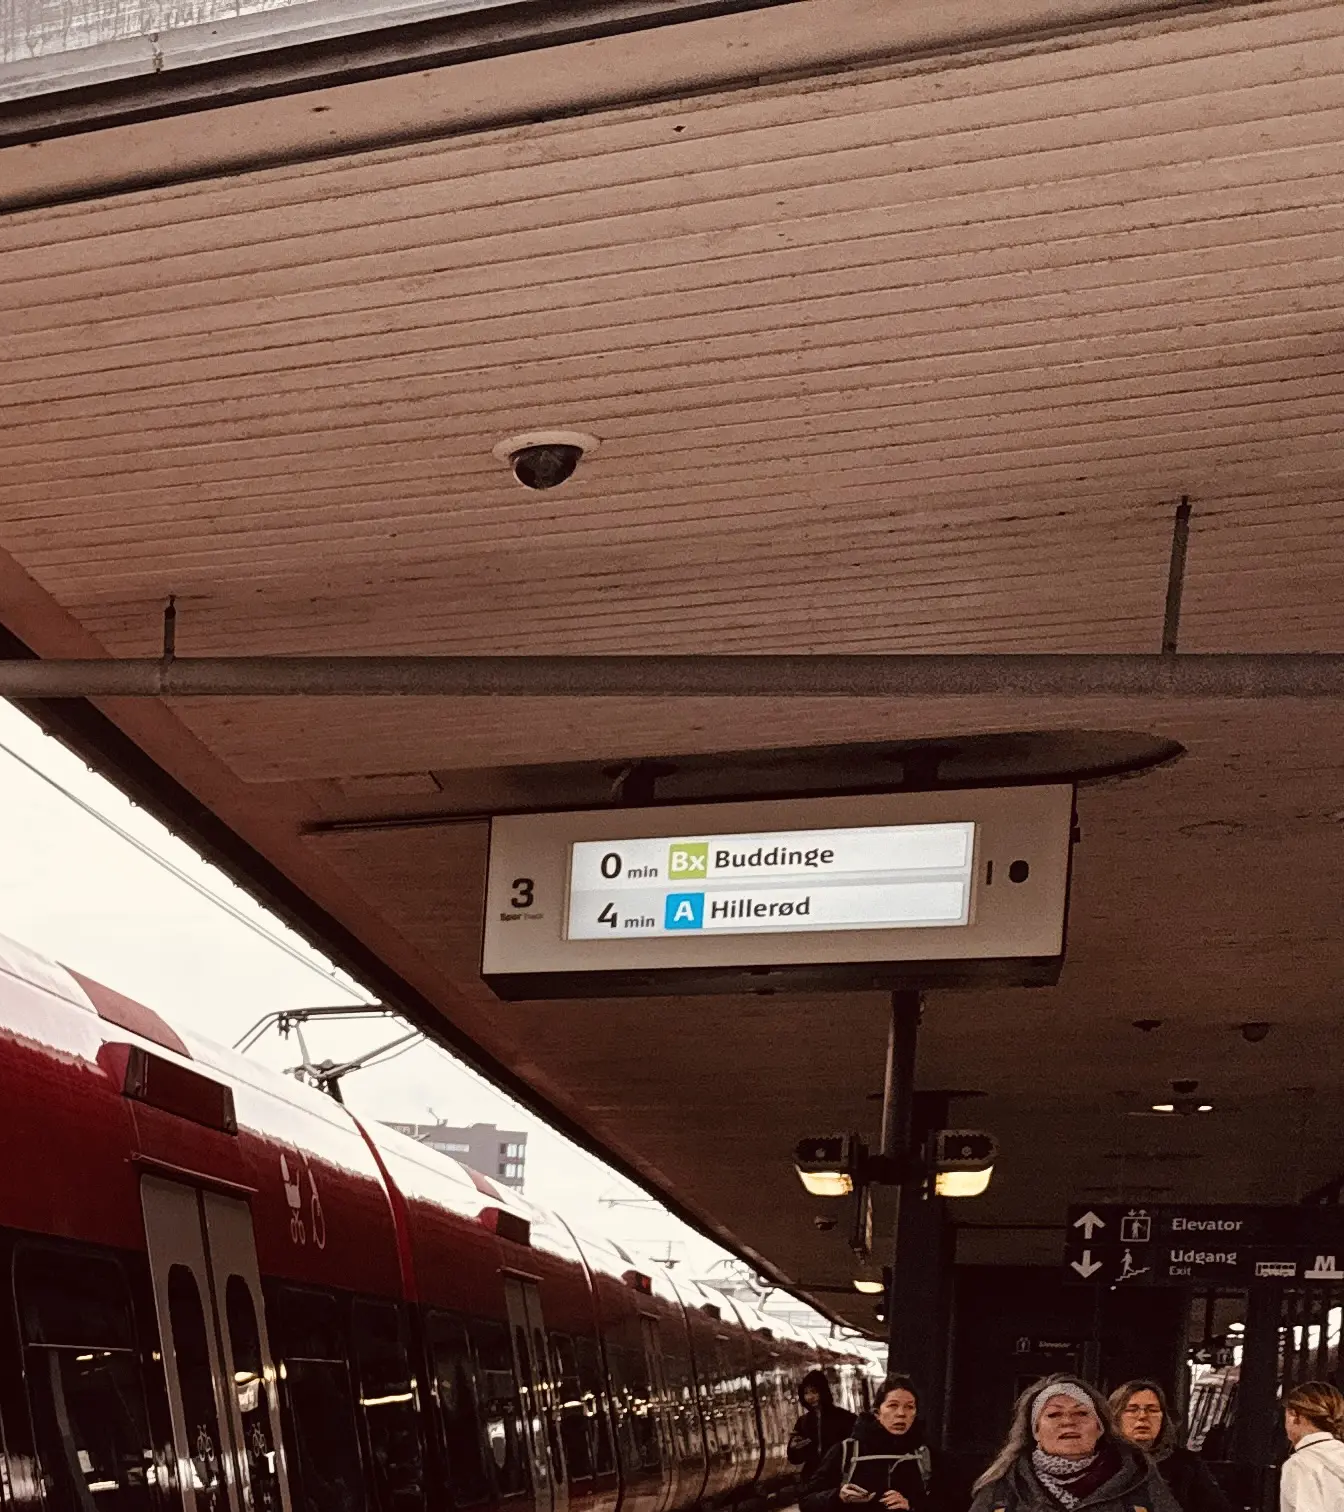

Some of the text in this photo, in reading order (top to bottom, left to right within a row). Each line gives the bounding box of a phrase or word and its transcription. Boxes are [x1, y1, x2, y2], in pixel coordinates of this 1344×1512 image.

[600, 847, 835, 879] 0 min Bx Buddinge
[511, 878, 534, 908] 3
[597, 897, 811, 928] 4 min A Hillerød
[1171, 1217, 1243, 1231] Elevator
[1170, 1250, 1238, 1265] Udgang
[1169, 1266, 1192, 1276] Exit
